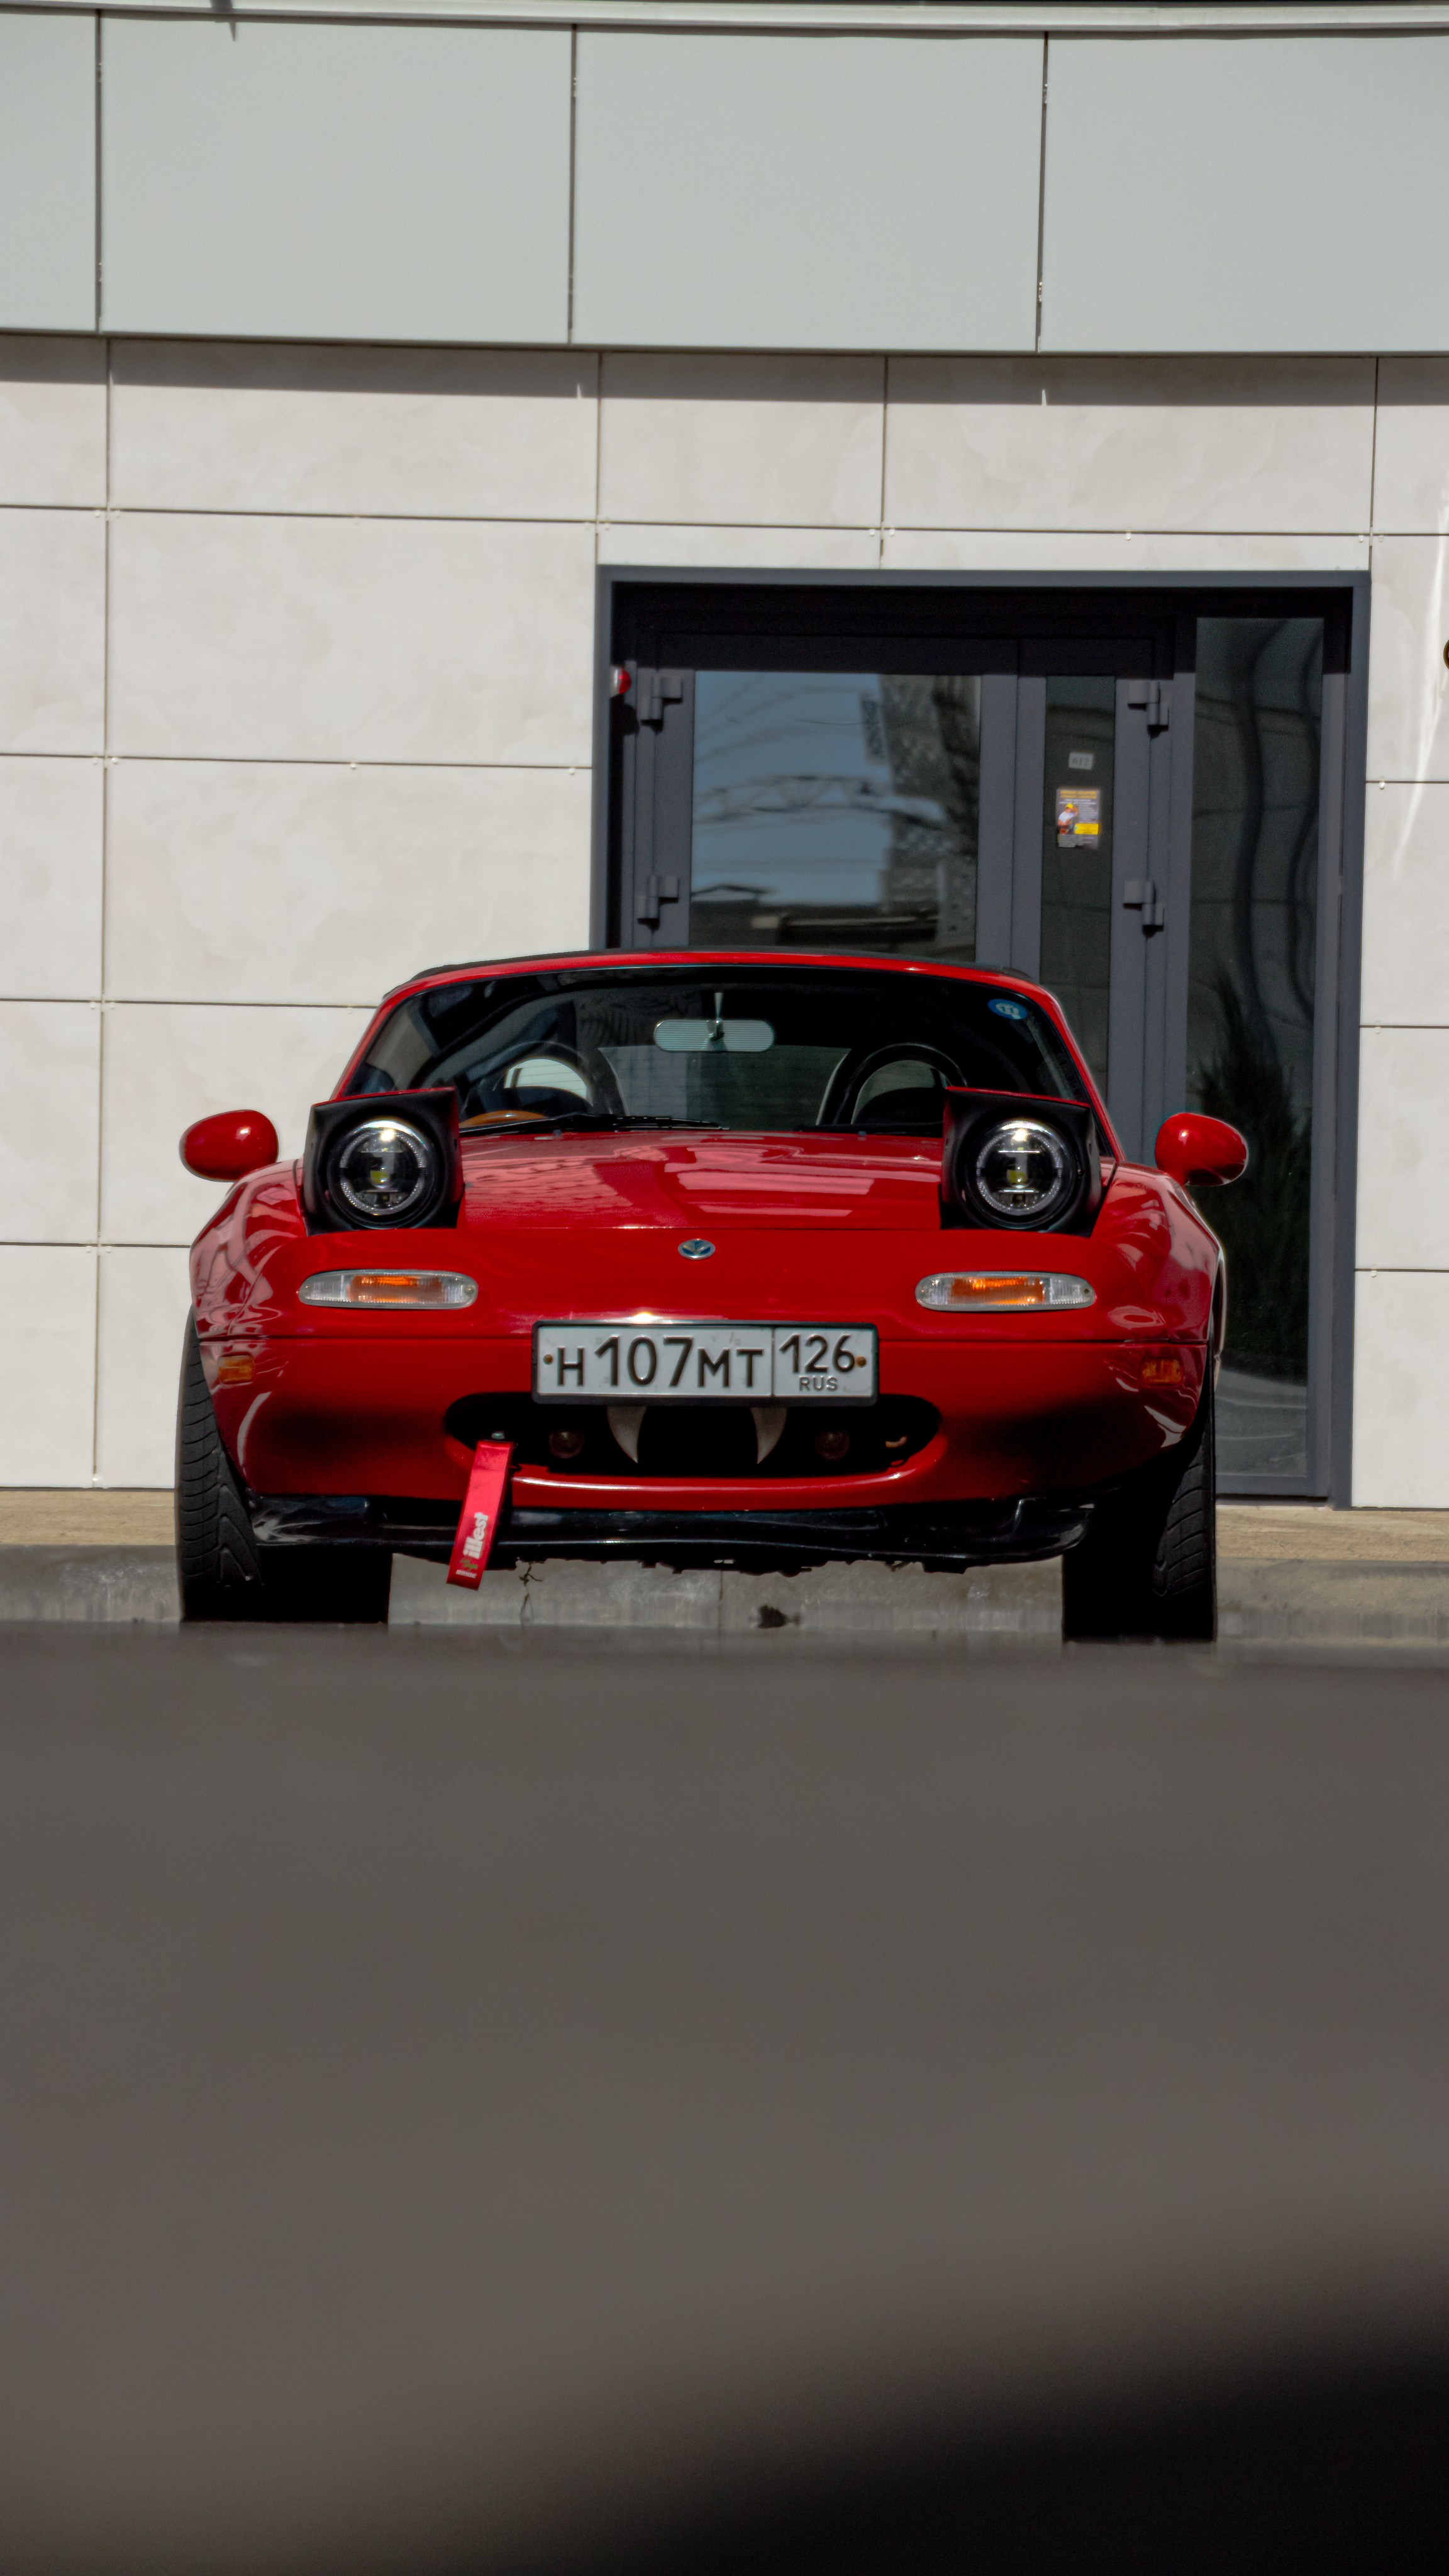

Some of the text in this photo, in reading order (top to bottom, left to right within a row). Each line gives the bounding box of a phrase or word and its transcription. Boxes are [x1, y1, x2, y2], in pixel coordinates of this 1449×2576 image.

[779, 1334, 855, 1374] 126
[799, 1376, 838, 1392] RUS
[464, 1512, 488, 1558] illest
